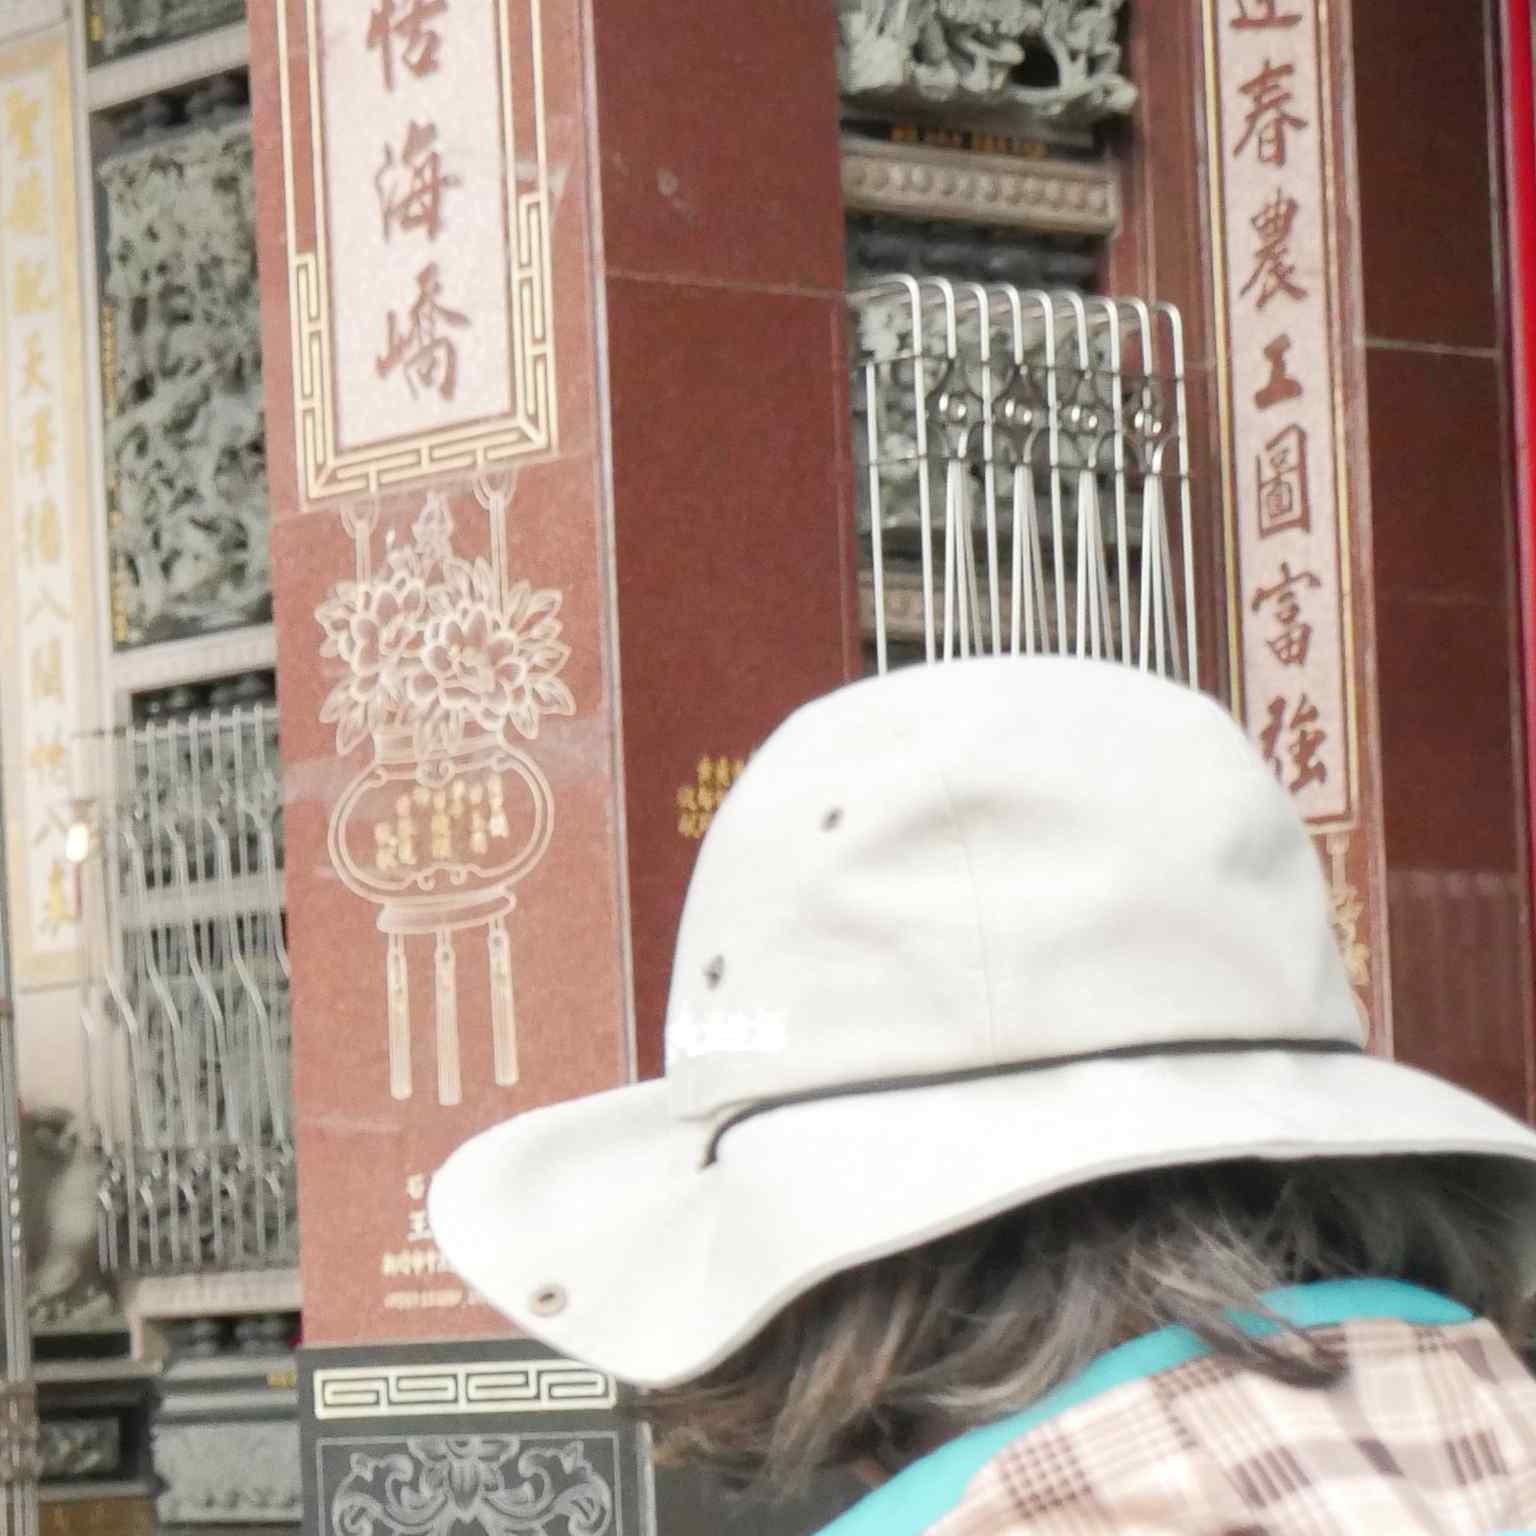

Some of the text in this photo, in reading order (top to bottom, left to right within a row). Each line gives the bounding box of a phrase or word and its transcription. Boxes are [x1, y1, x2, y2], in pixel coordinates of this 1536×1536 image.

[1229, 0, 1328, 797] 春農工圖富強
